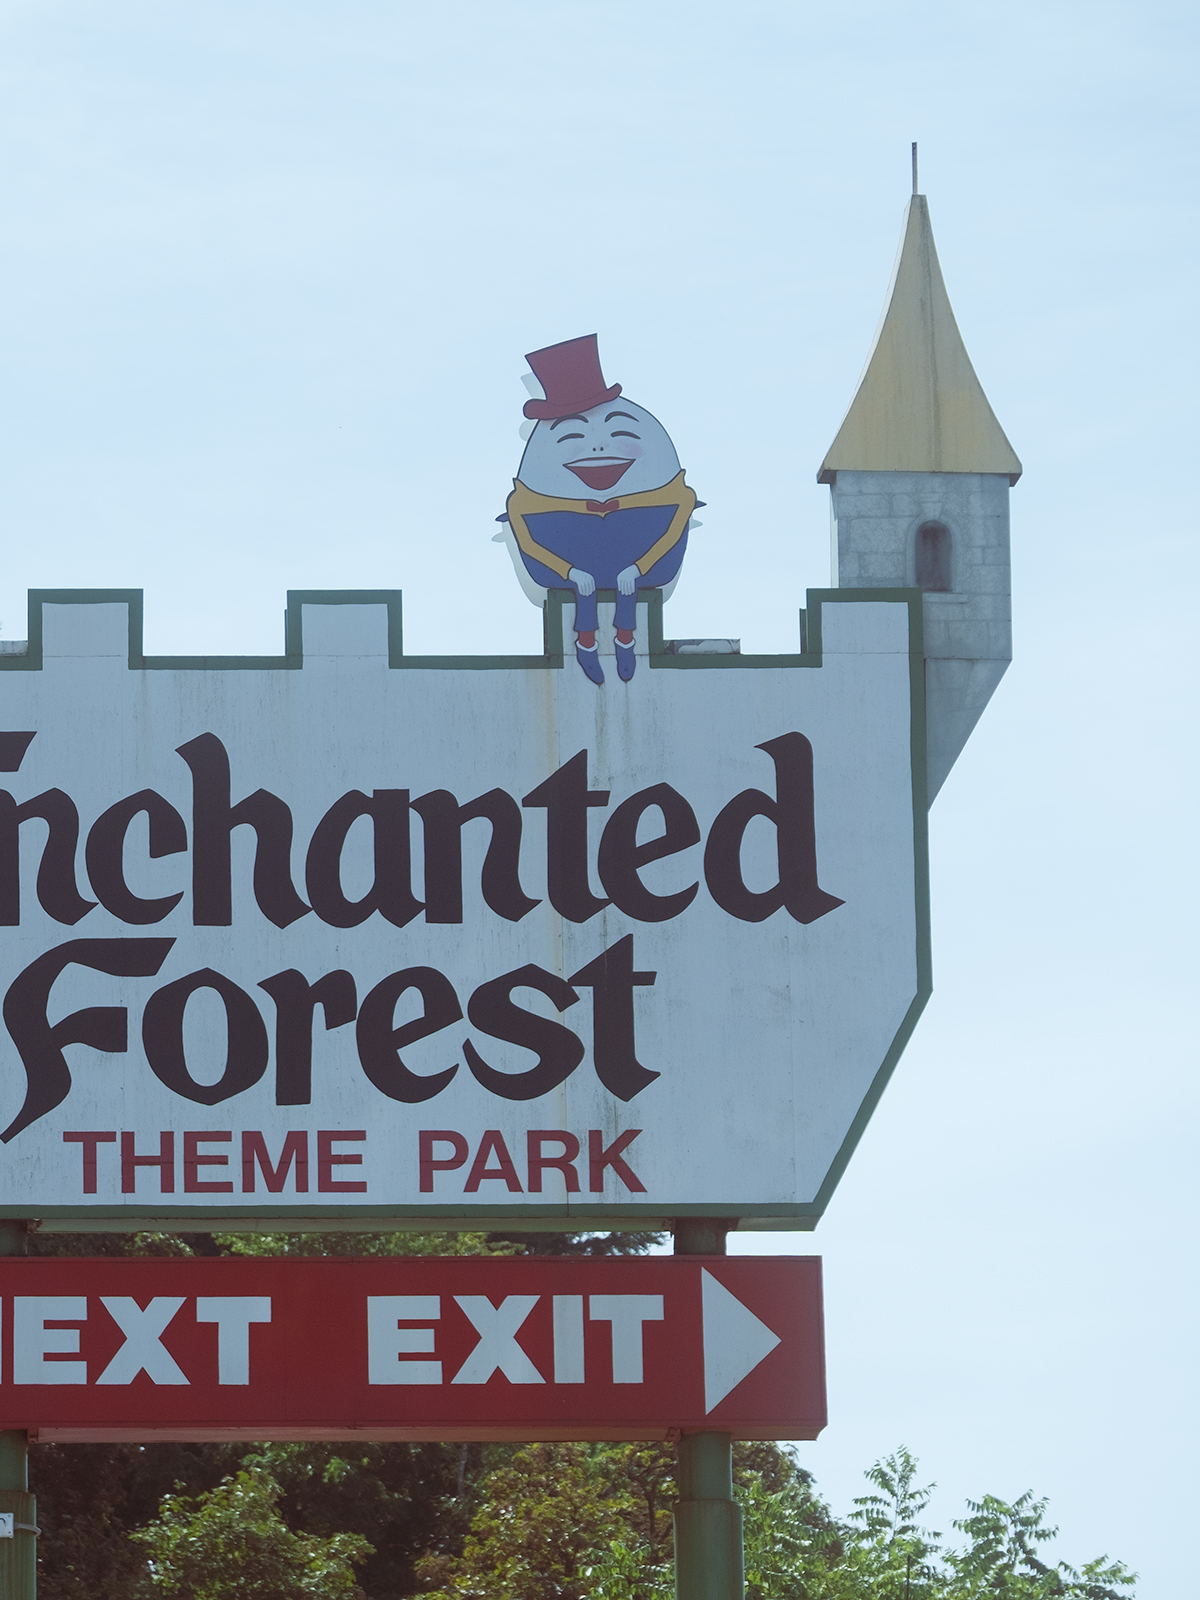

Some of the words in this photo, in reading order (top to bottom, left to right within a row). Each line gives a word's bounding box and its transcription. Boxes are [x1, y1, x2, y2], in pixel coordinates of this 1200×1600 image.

[63, 1130, 367, 1194] THEME
[419, 1129, 648, 1193] PARK
[367, 1295, 664, 1385] EXIT
